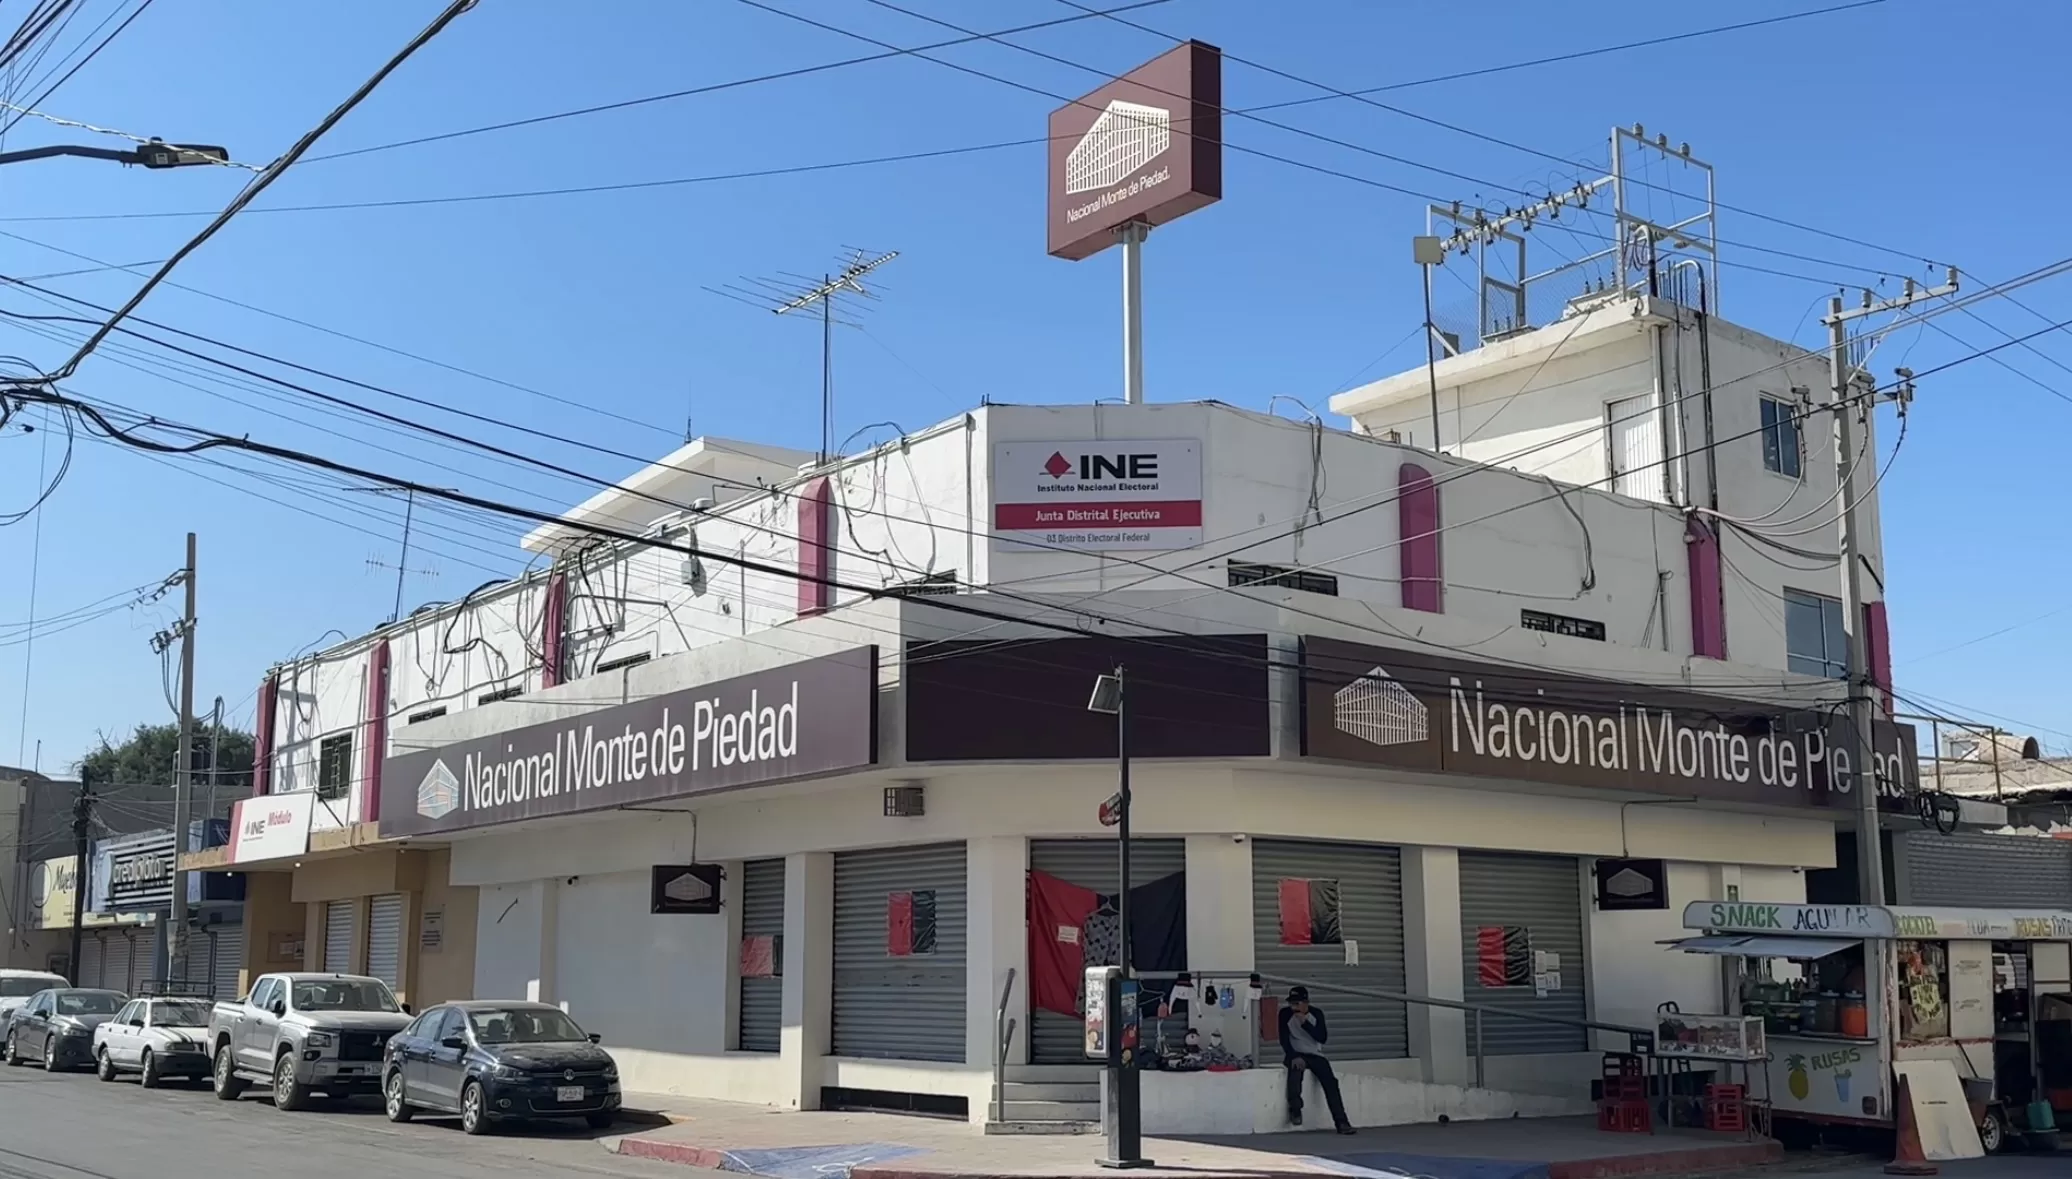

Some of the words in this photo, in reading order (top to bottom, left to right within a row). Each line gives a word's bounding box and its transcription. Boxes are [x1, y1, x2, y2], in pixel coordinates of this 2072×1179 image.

[1066, 196, 1101, 224] Nacional
[1101, 187, 1127, 209] Monte
[1128, 181, 1139, 197] de
[1080, 454, 1158, 480] INE
[1037, 484, 1075, 493] Instituto
[1077, 483, 1116, 492] Nacional
[1119, 482, 1159, 491] Electoral
[1035, 510, 1064, 522] Junta
[1067, 508, 1109, 520] Distrital
[1113, 508, 1160, 523] Ejecutiva
[1058, 534, 1086, 543] Distrito
[1087, 533, 1120, 543] Electoral
[1122, 533, 1150, 542] Federal
[464, 732, 561, 811] Nacional
[565, 723, 648, 793] Monte
[651, 707, 685, 776] de
[692, 681, 798, 772] Piedad
[1450, 677, 1628, 770] Nacional
[1635, 701, 1750, 783] Monte
[1757, 717, 1798, 788] de
[1804, 726, 1905, 799] Piead
[250, 820, 265, 835] INE
[267, 809, 292, 826] Módulo
[1711, 903, 1781, 929] SNACK
[1811, 1047, 1861, 1071] RUSAS
